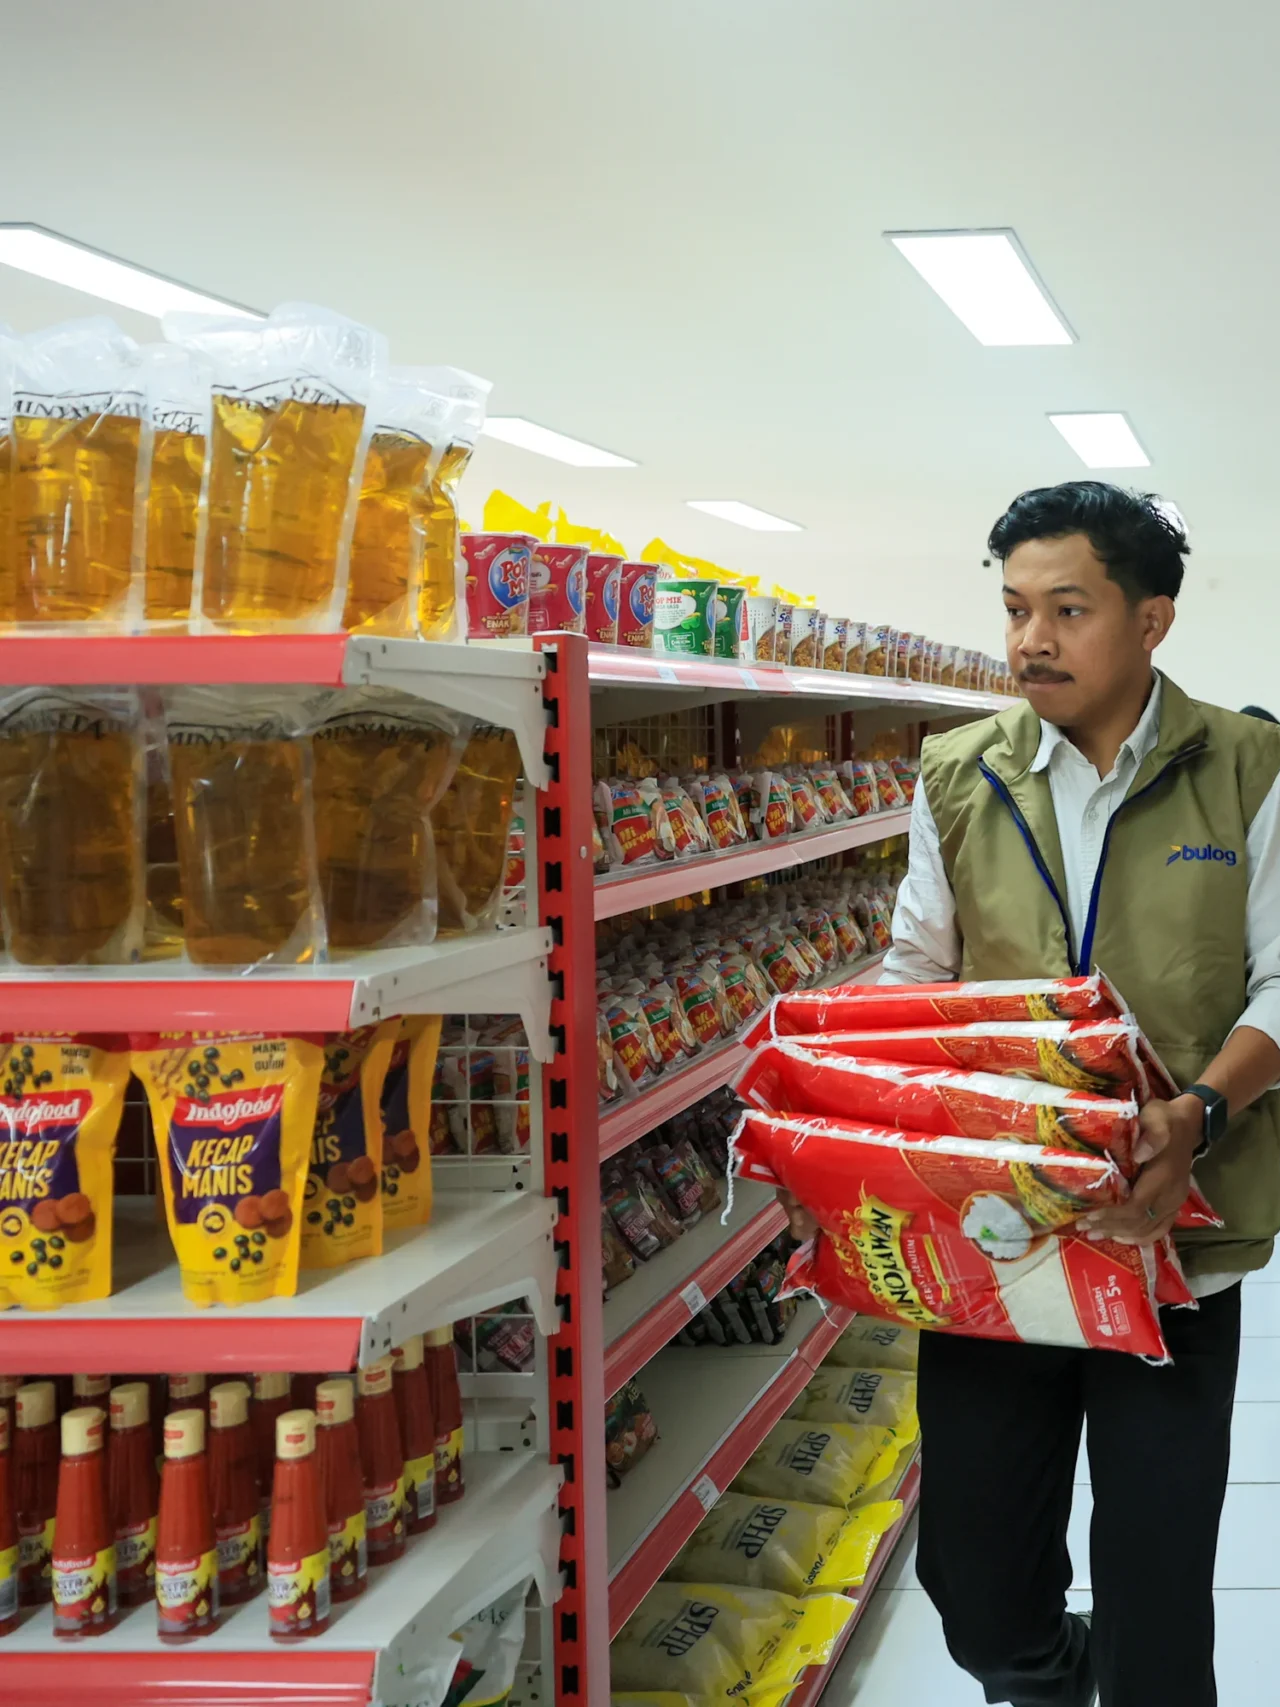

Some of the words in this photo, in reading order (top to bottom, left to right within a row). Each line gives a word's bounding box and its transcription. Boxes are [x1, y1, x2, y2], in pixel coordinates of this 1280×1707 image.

[1182, 844, 1236, 866] bulog
[0, 1097, 82, 1126] ndofood
[185, 1092, 276, 1125] Indofood
[187, 1134, 254, 1168] KECAP
[0, 1168, 54, 1200] ANIS
[182, 1165, 253, 1199] MANIS
[849, 1372, 882, 1414] SPHP
[790, 1431, 831, 1475] SPHP
[736, 1505, 788, 1559] SPHP
[658, 1601, 719, 1657] SPHP
